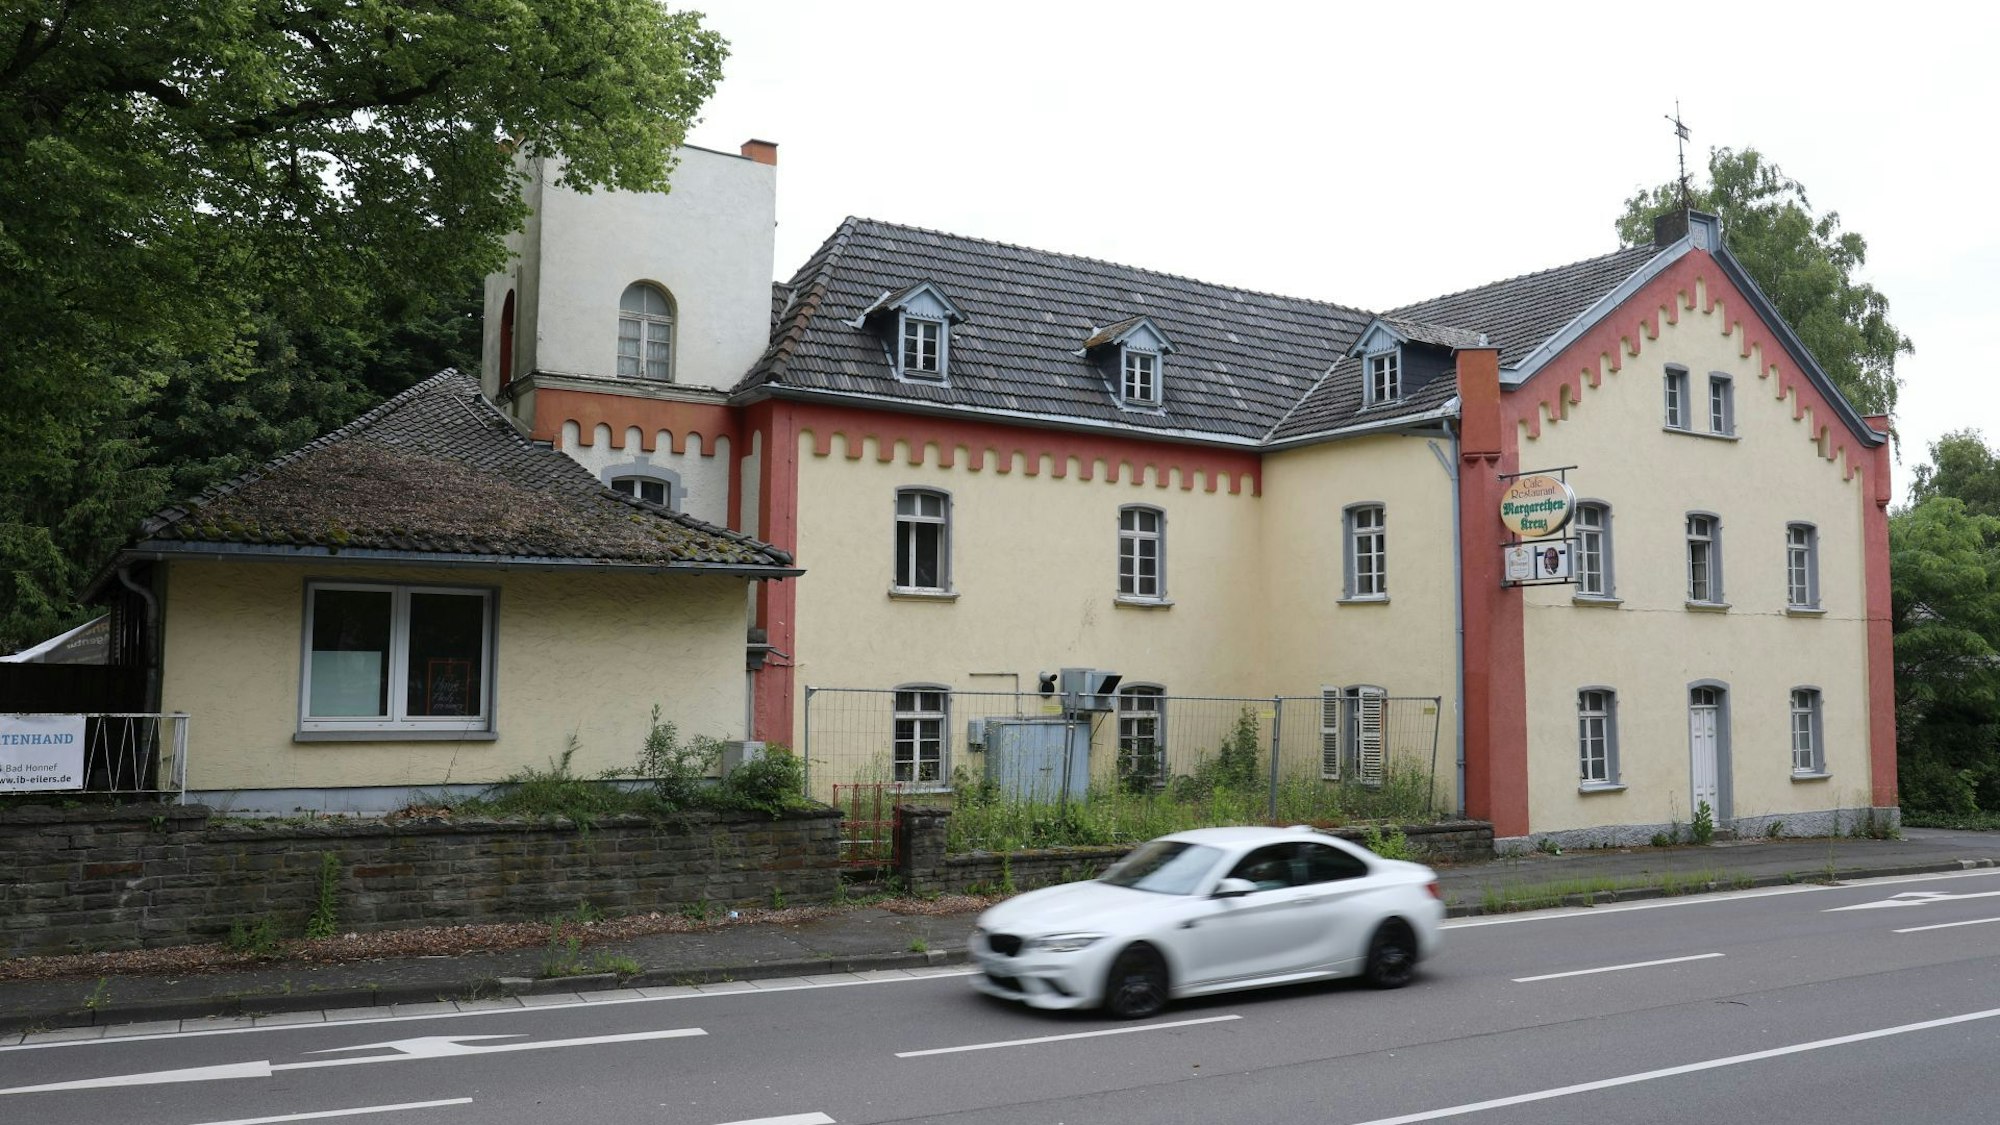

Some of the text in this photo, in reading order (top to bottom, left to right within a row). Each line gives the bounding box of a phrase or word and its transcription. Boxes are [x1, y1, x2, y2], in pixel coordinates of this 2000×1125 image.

[1511, 486, 1555, 499] Restaurant
[1503, 498, 1565, 517] Margarethen-
[1521, 518, 1547, 532] Kreuz
[0, 733, 74, 746] TENHAND
[5, 763, 23, 773] Bad
[25, 762, 58, 772] Honnef
